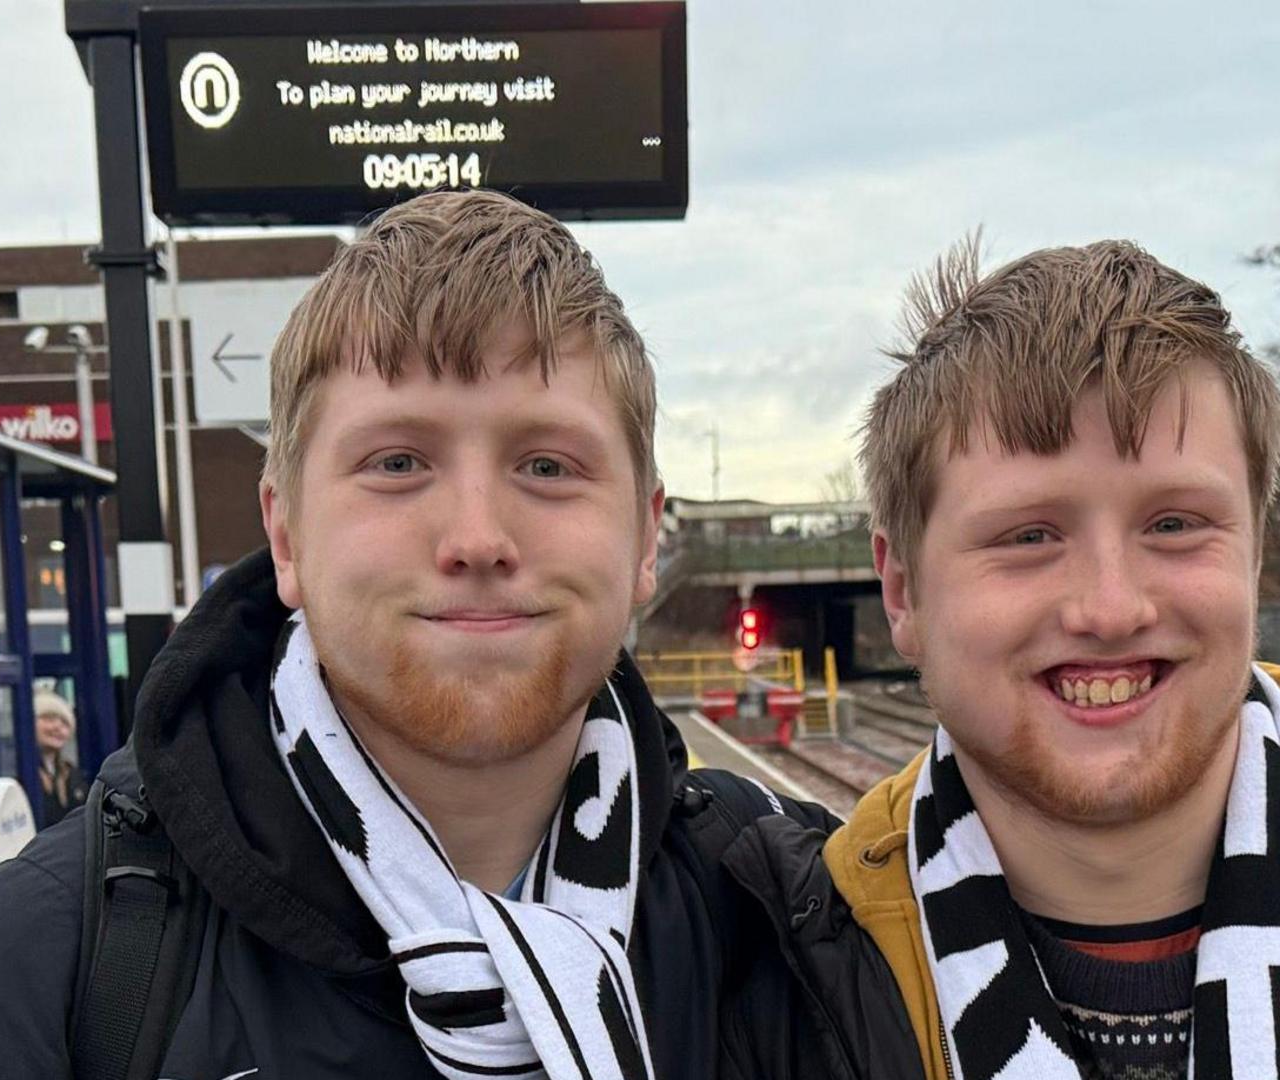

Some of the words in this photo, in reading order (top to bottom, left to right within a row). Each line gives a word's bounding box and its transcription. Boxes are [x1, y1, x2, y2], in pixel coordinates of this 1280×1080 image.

[306, 41, 388, 64] Welcome
[394, 38, 419, 62] to
[424, 37, 519, 62] Northern
[275, 80, 304, 105] To
[309, 79, 356, 108] plan
[361, 83, 411, 108] your
[417, 80, 498, 107] journey
[503, 76, 556, 101] visit
[328, 117, 506, 145] nationalrail.co.uk
[362, 152, 483, 189] 09:05:14
[0, 405, 79, 440] wilko
